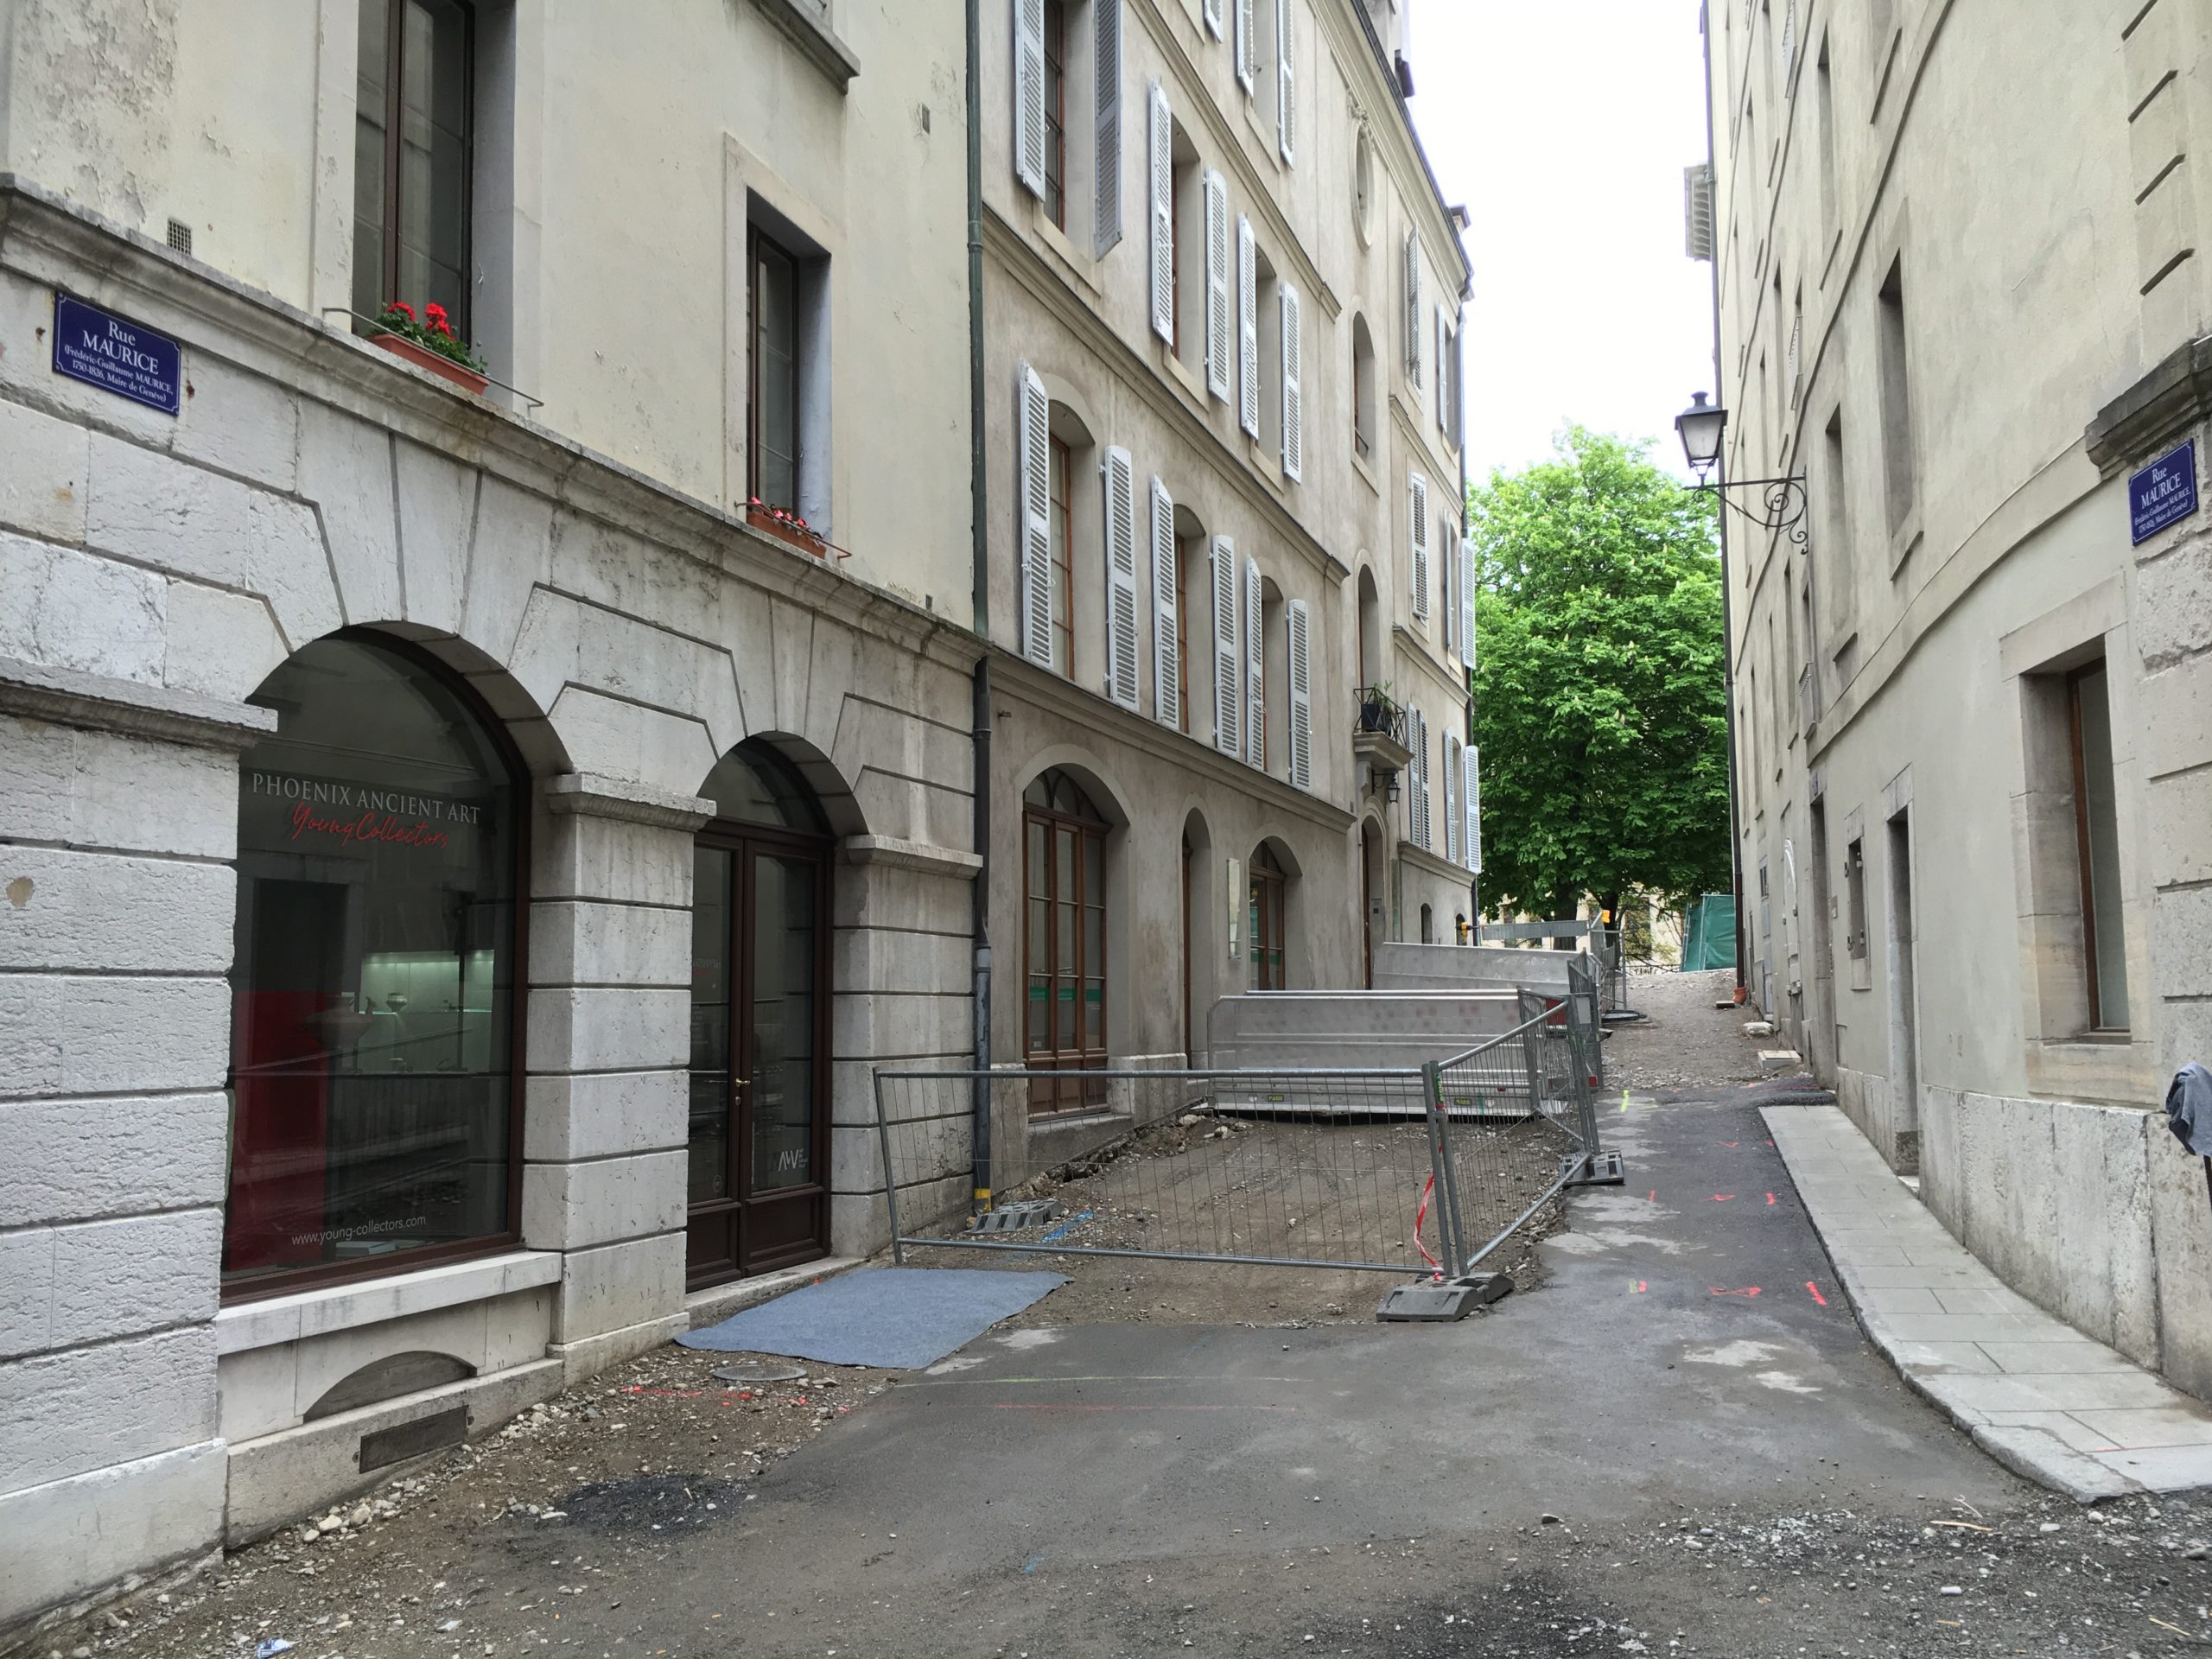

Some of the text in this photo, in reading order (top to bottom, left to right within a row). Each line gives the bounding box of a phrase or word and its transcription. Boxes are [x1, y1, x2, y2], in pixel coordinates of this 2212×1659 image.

[109, 321, 136, 346] Rue
[83, 330, 159, 375] MAURICE
[107, 372, 127, 387] Maire
[129, 382, 137, 391] de
[2152, 467, 2167, 484] Rue
[2141, 472, 2181, 509] MAURICE
[252, 772, 480, 823] PHOENIX ANCIENT ART
[292, 1216, 426, 1245] www.young-collectors.com
